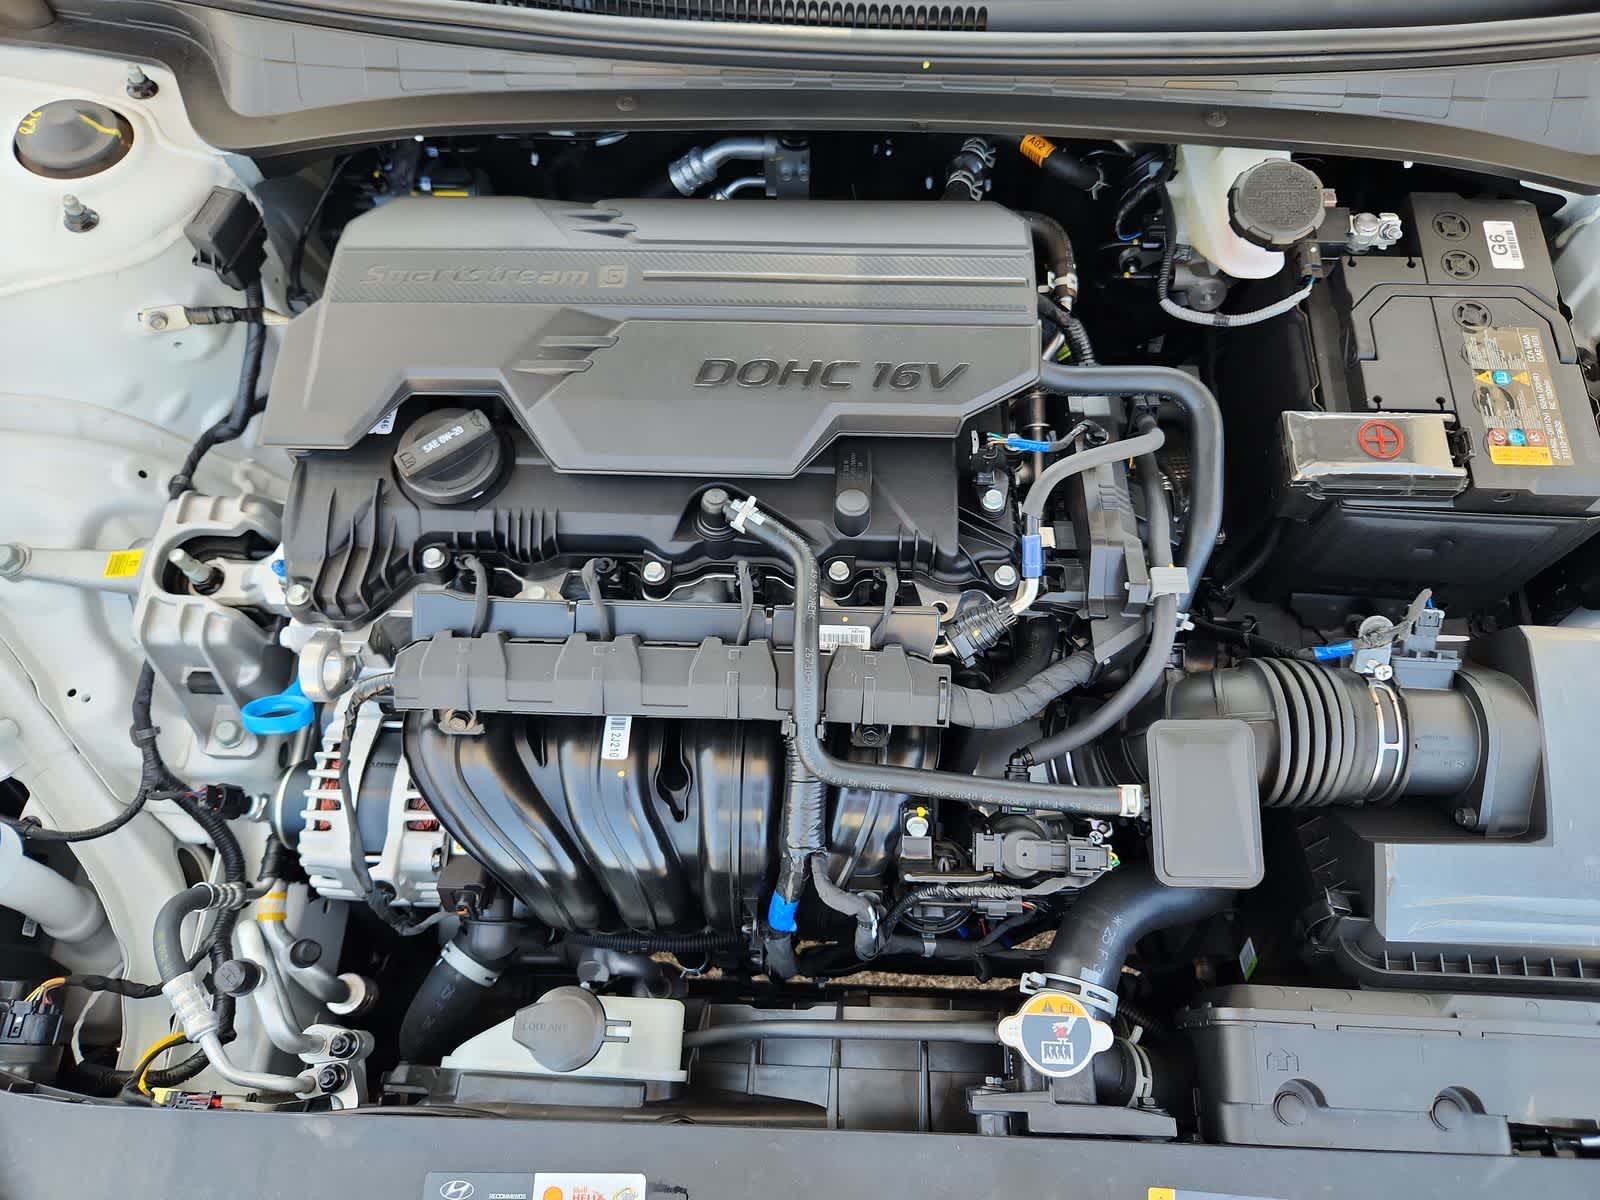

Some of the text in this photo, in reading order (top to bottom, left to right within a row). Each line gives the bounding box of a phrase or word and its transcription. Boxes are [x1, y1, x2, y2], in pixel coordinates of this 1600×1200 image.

[1488, 233, 1508, 256] G6
[693, 358, 970, 391] DOHC 16V
[422, 425, 465, 454] SAE 0W-20
